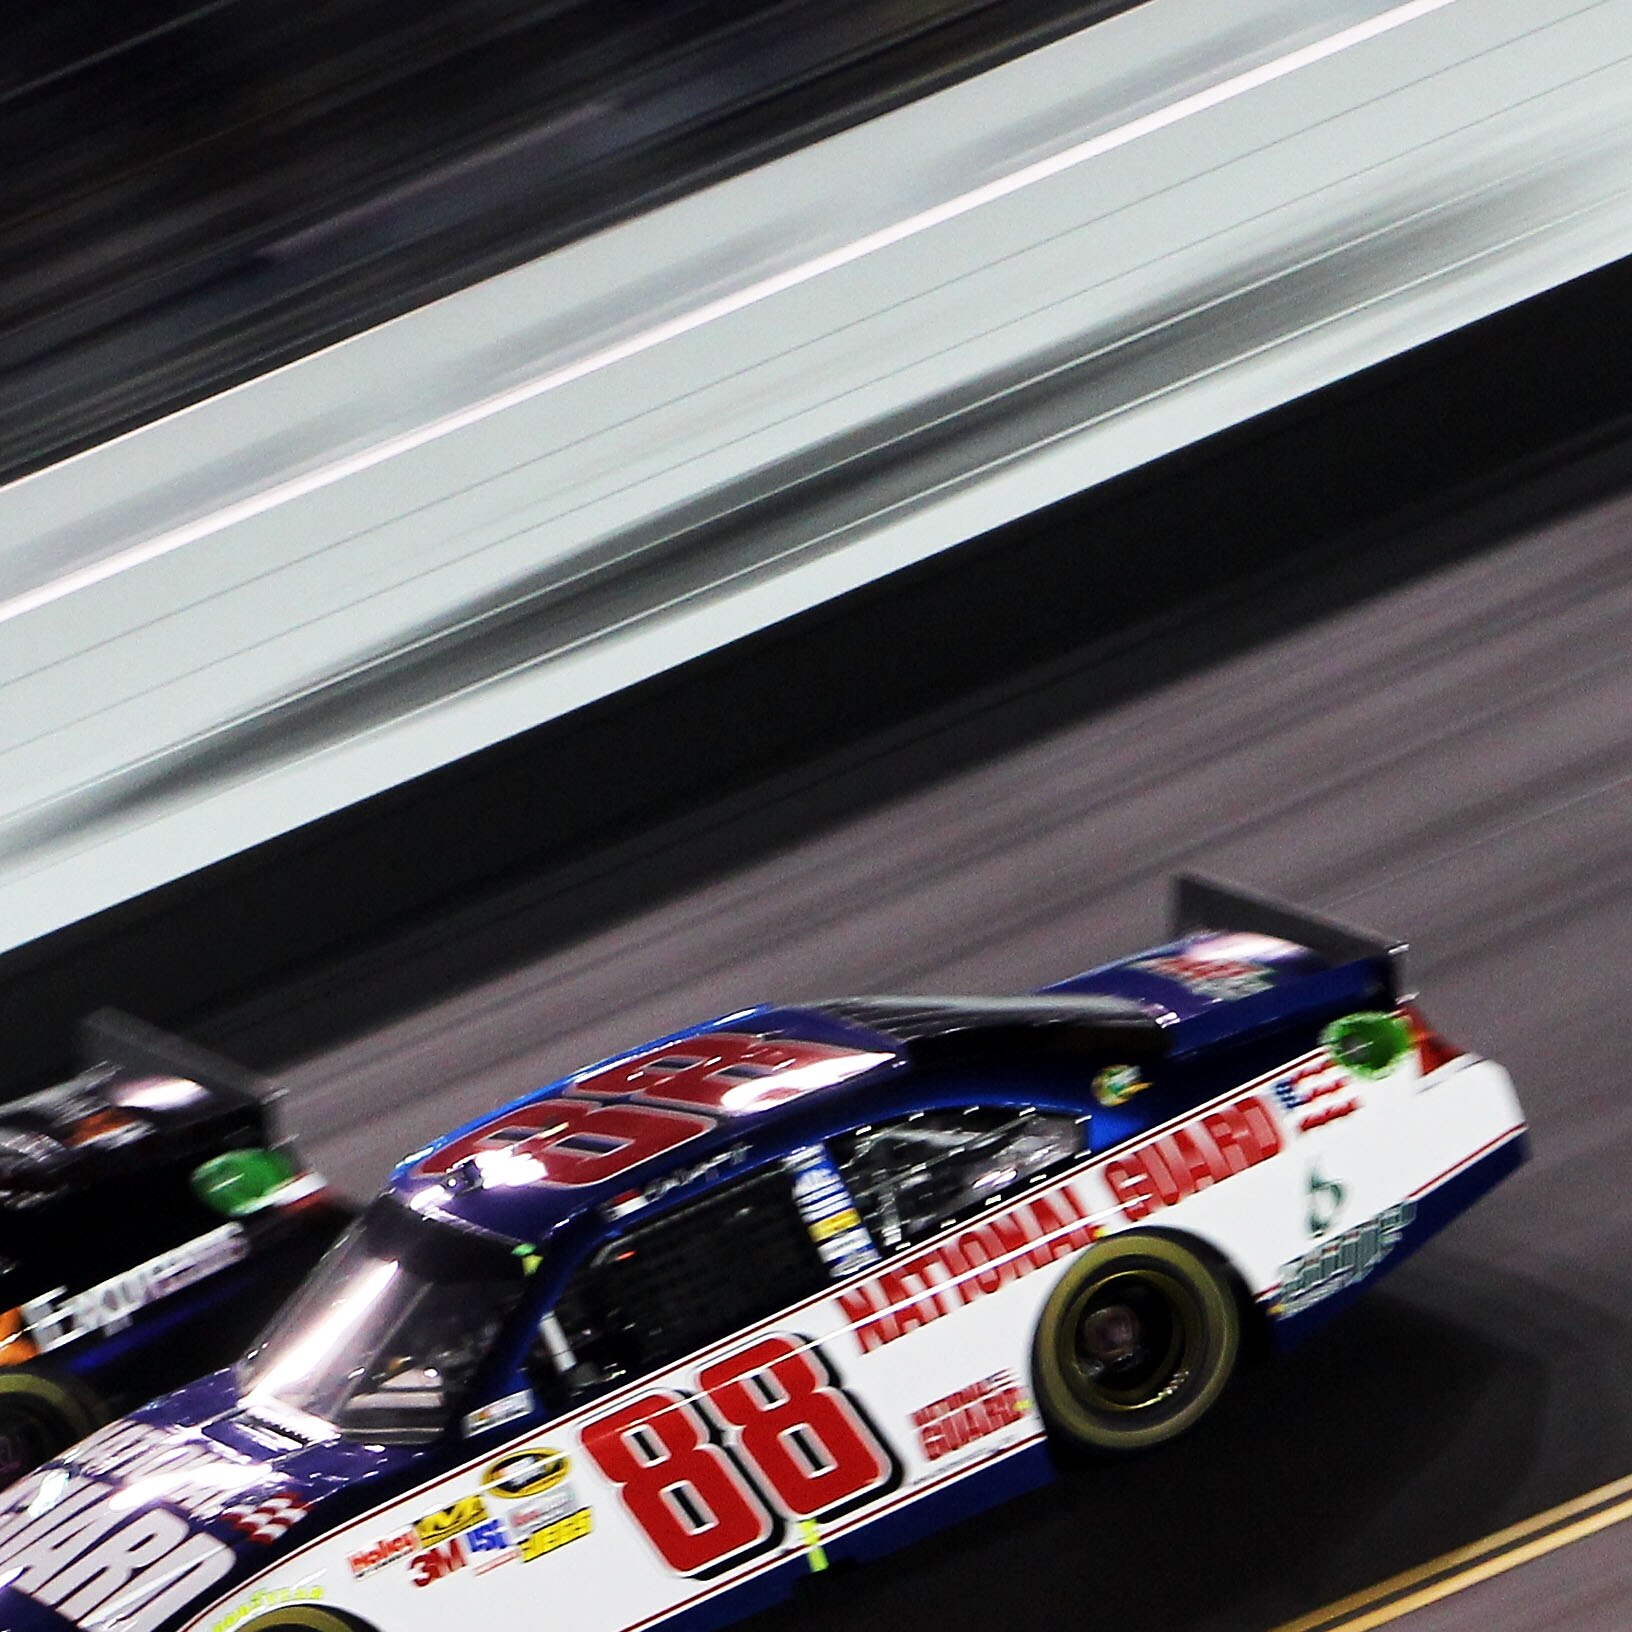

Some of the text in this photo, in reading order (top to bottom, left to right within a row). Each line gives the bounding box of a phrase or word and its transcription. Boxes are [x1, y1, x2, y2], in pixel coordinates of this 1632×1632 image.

[411, 1032, 888, 1188] 88
[834, 1180, 1106, 1354] NATIONAL
[1101, 1096, 1286, 1224] GUARD
[579, 1335, 898, 1580] 88
[408, 1538, 466, 1588] 3M
